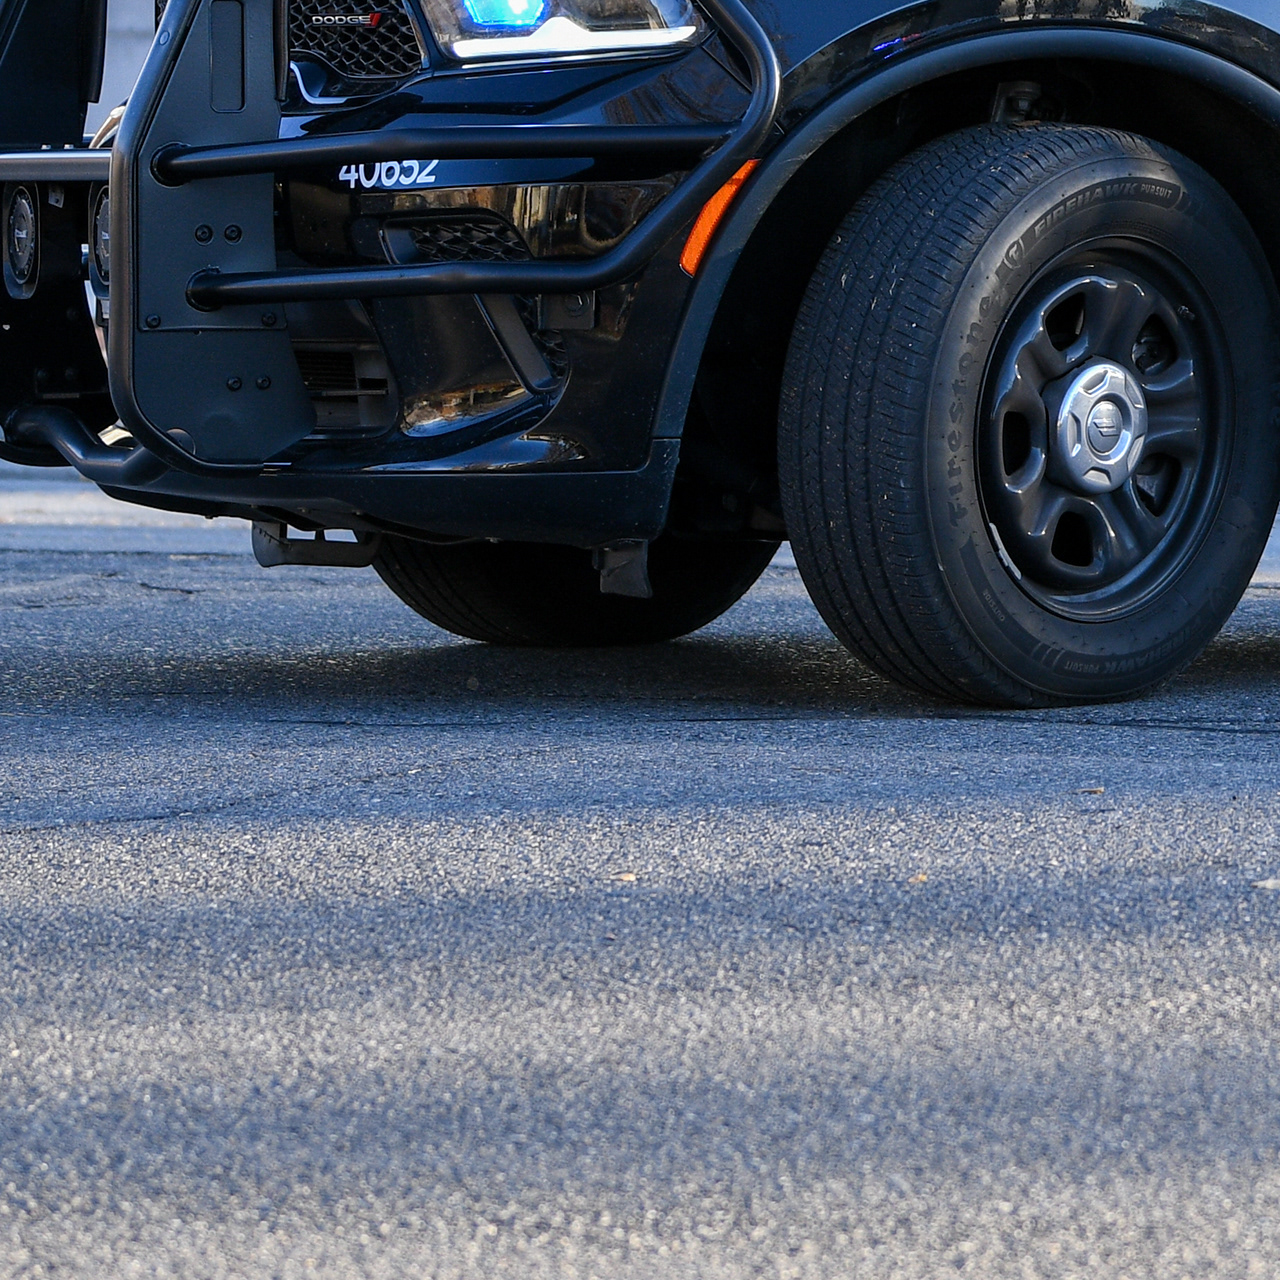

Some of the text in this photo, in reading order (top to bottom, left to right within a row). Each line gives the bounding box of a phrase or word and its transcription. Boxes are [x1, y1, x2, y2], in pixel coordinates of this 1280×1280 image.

[311, 14, 372, 25] DODGE
[1032, 182, 1173, 238] FIREHAWK PURSUIT
[946, 296, 992, 528] Firestone
